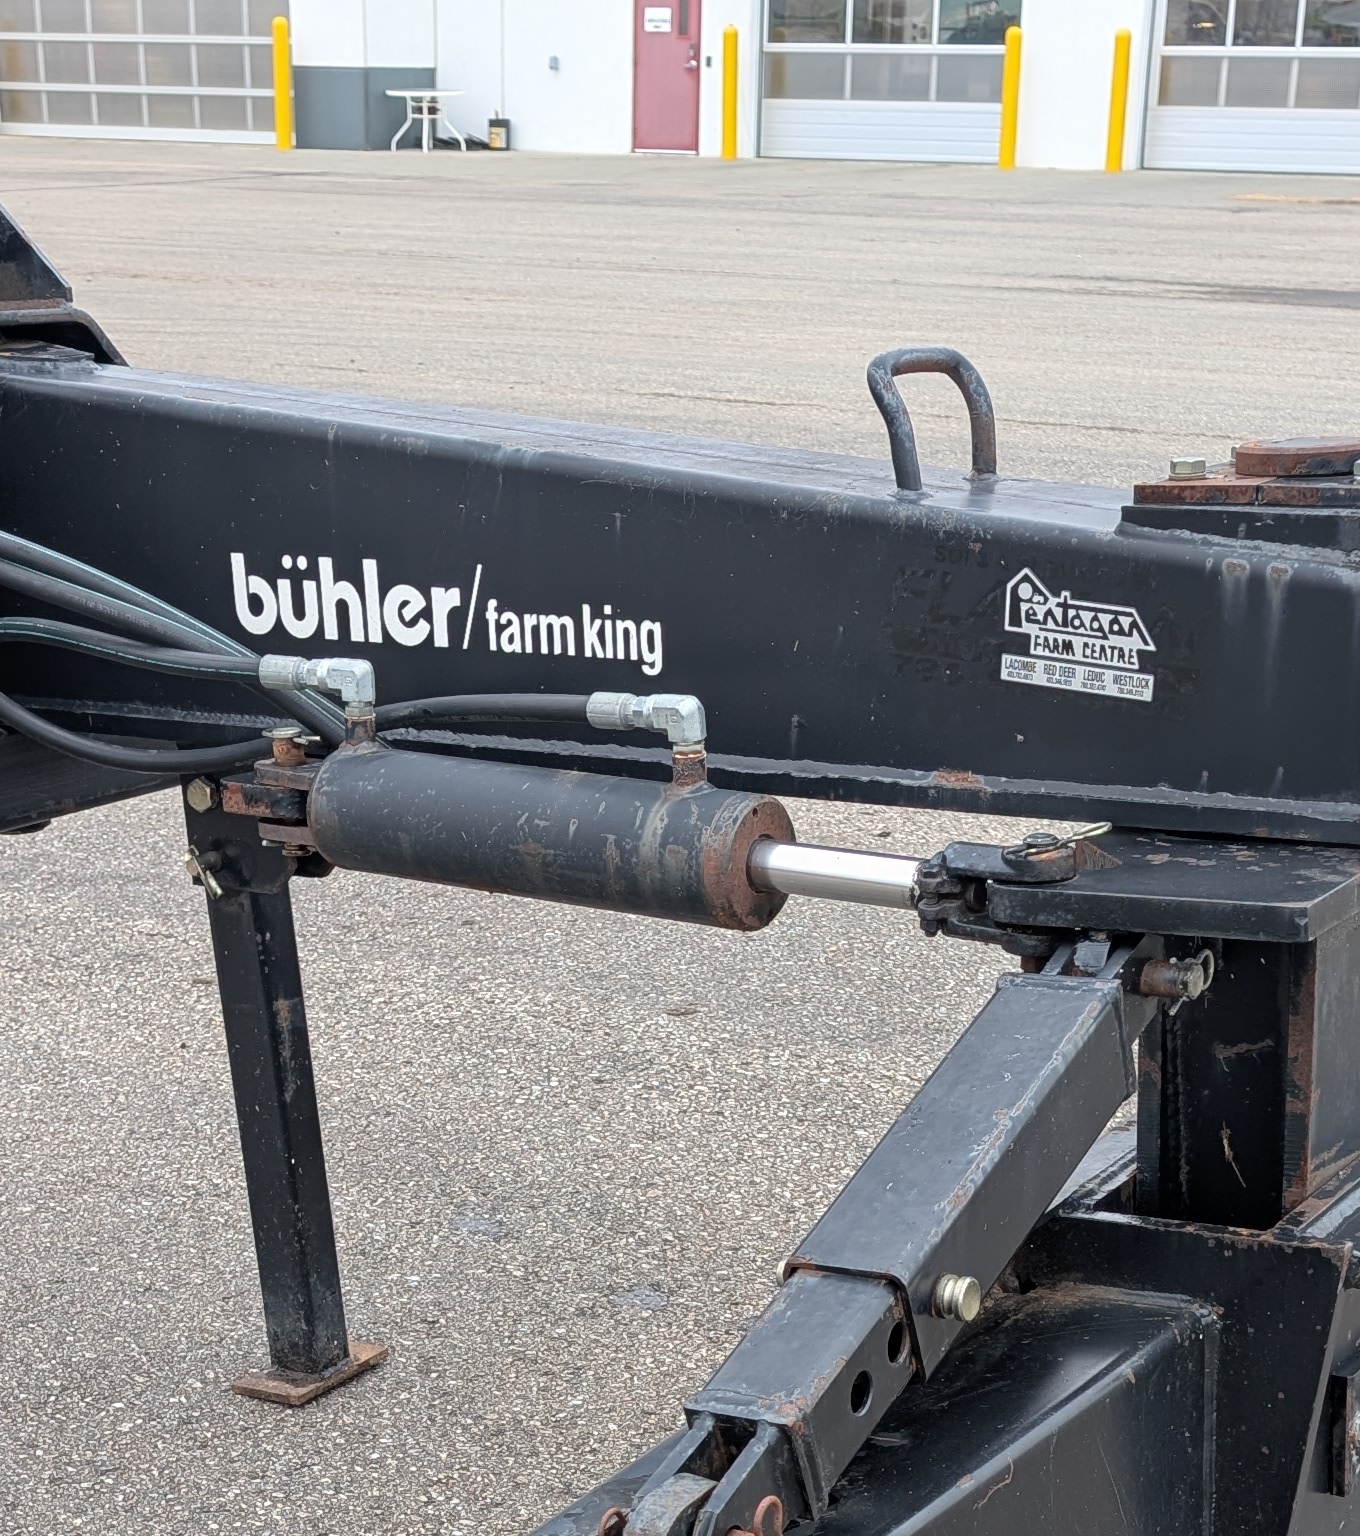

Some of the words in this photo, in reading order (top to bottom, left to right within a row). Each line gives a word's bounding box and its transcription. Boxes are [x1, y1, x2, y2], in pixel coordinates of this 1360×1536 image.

[486, 599, 575, 657] farm
[582, 604, 663, 676] king
[1033, 635, 1076, 657] FARM
[1082, 641, 1137, 666] CENTRE
[1004, 657, 1037, 673] LACOMBE
[1043, 663, 1058, 676] RED
[1058, 666, 1077, 679] DEER
[1083, 669, 1106, 684] LEDUC
[1112, 673, 1151, 690] WESTLOCK
